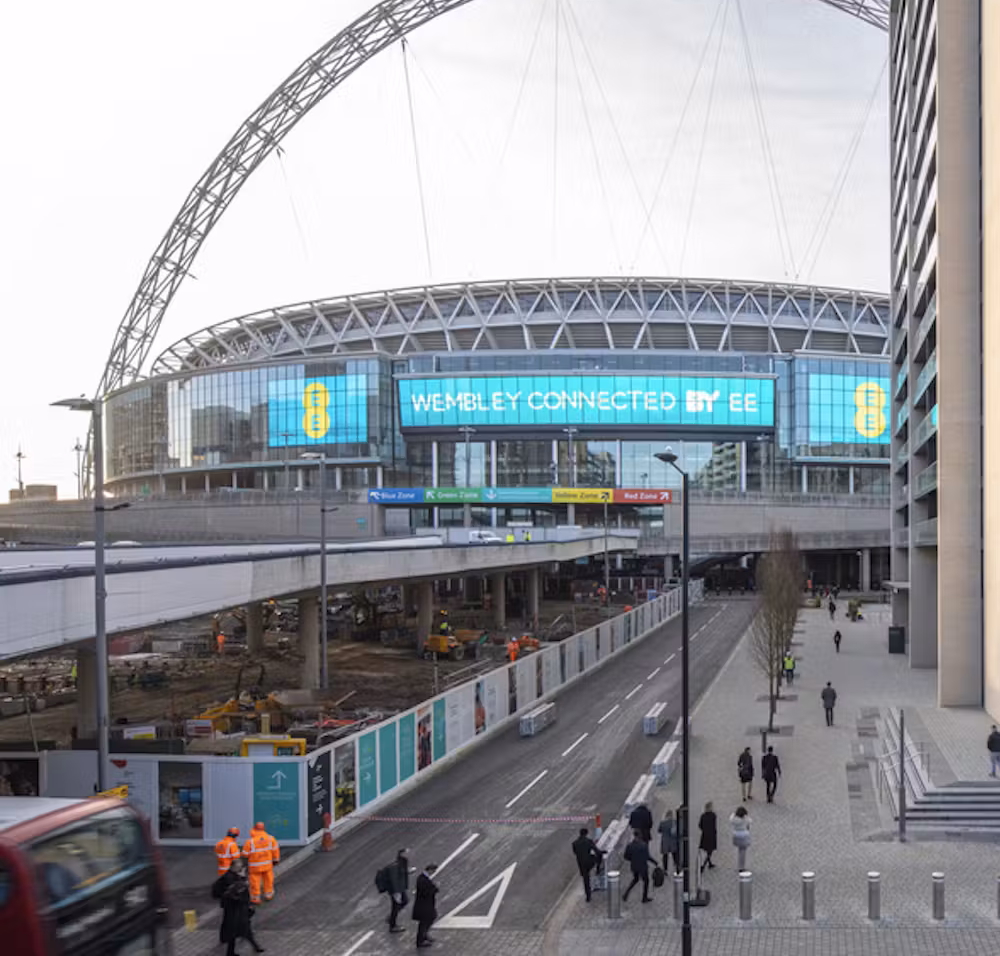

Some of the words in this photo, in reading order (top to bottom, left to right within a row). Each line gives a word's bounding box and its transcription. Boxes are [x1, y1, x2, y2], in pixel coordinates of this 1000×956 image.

[411, 390, 521, 412] WEMBLEY
[527, 390, 676, 411] CONNECTED
[686, 389, 720, 412] BY
[729, 392, 758, 413] EE
[380, 491, 396, 500] Blue
[398, 491, 416, 500] Zone
[437, 491, 458, 500] Green
[460, 491, 479, 500] Zone
[579, 492, 599, 500] Zone
[623, 492, 639, 500] Red
[640, 492, 658, 501] Zone
